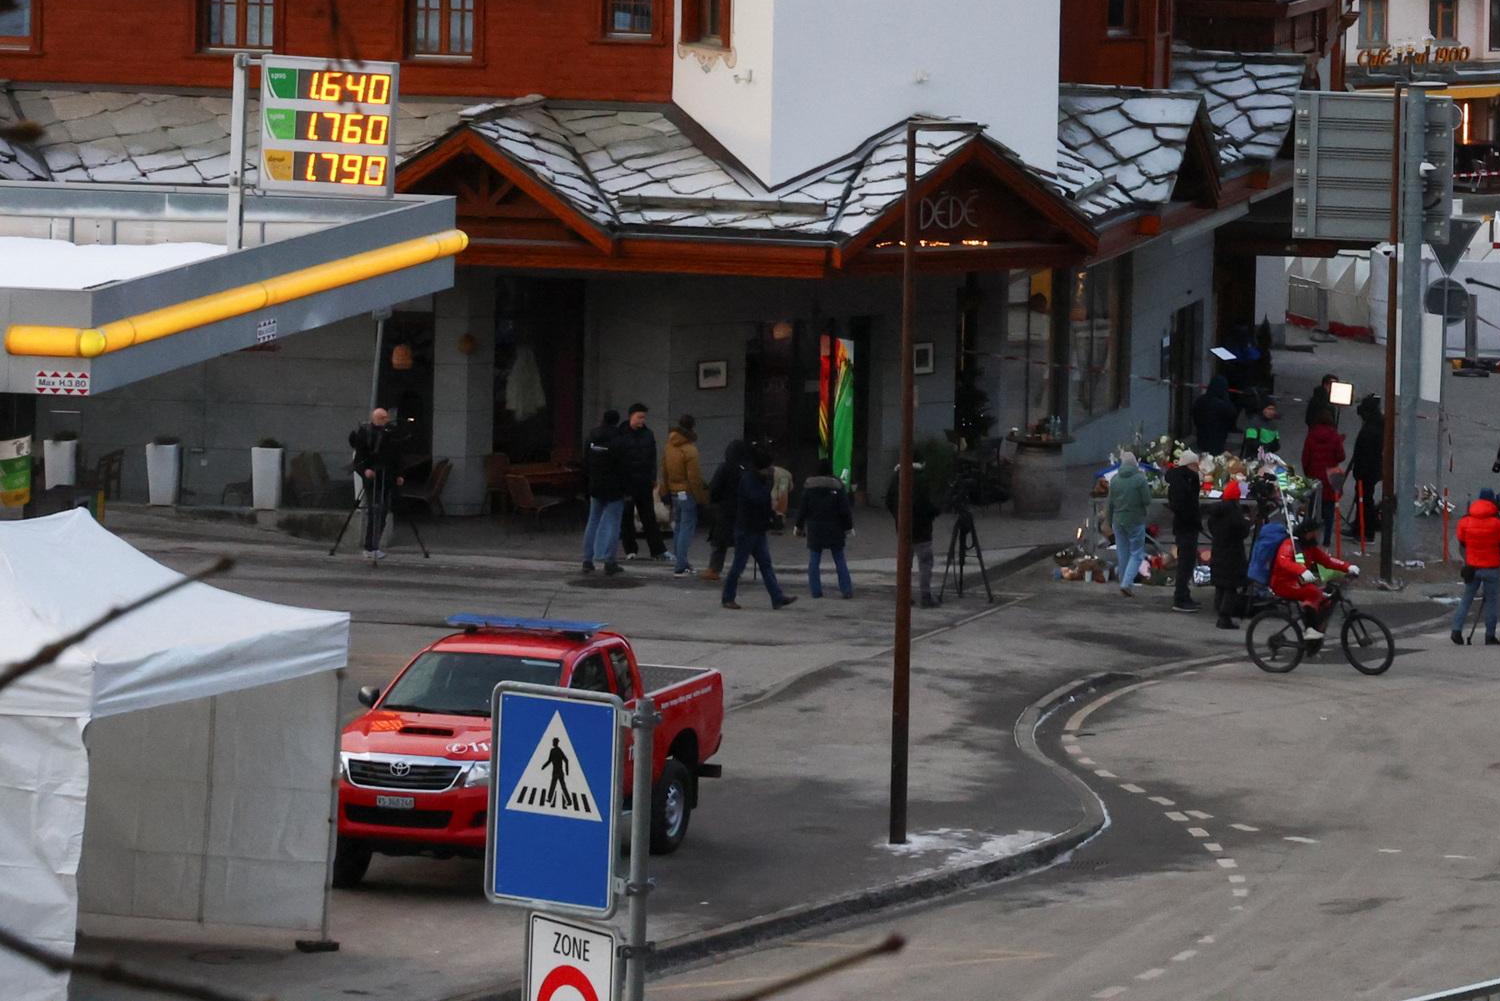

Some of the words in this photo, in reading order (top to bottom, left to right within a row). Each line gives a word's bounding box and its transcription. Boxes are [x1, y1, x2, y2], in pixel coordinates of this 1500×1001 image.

[1435, 46, 1471, 63] 1900
[468, 742, 491, 753] 11
[553, 931, 591, 962] ZONE
